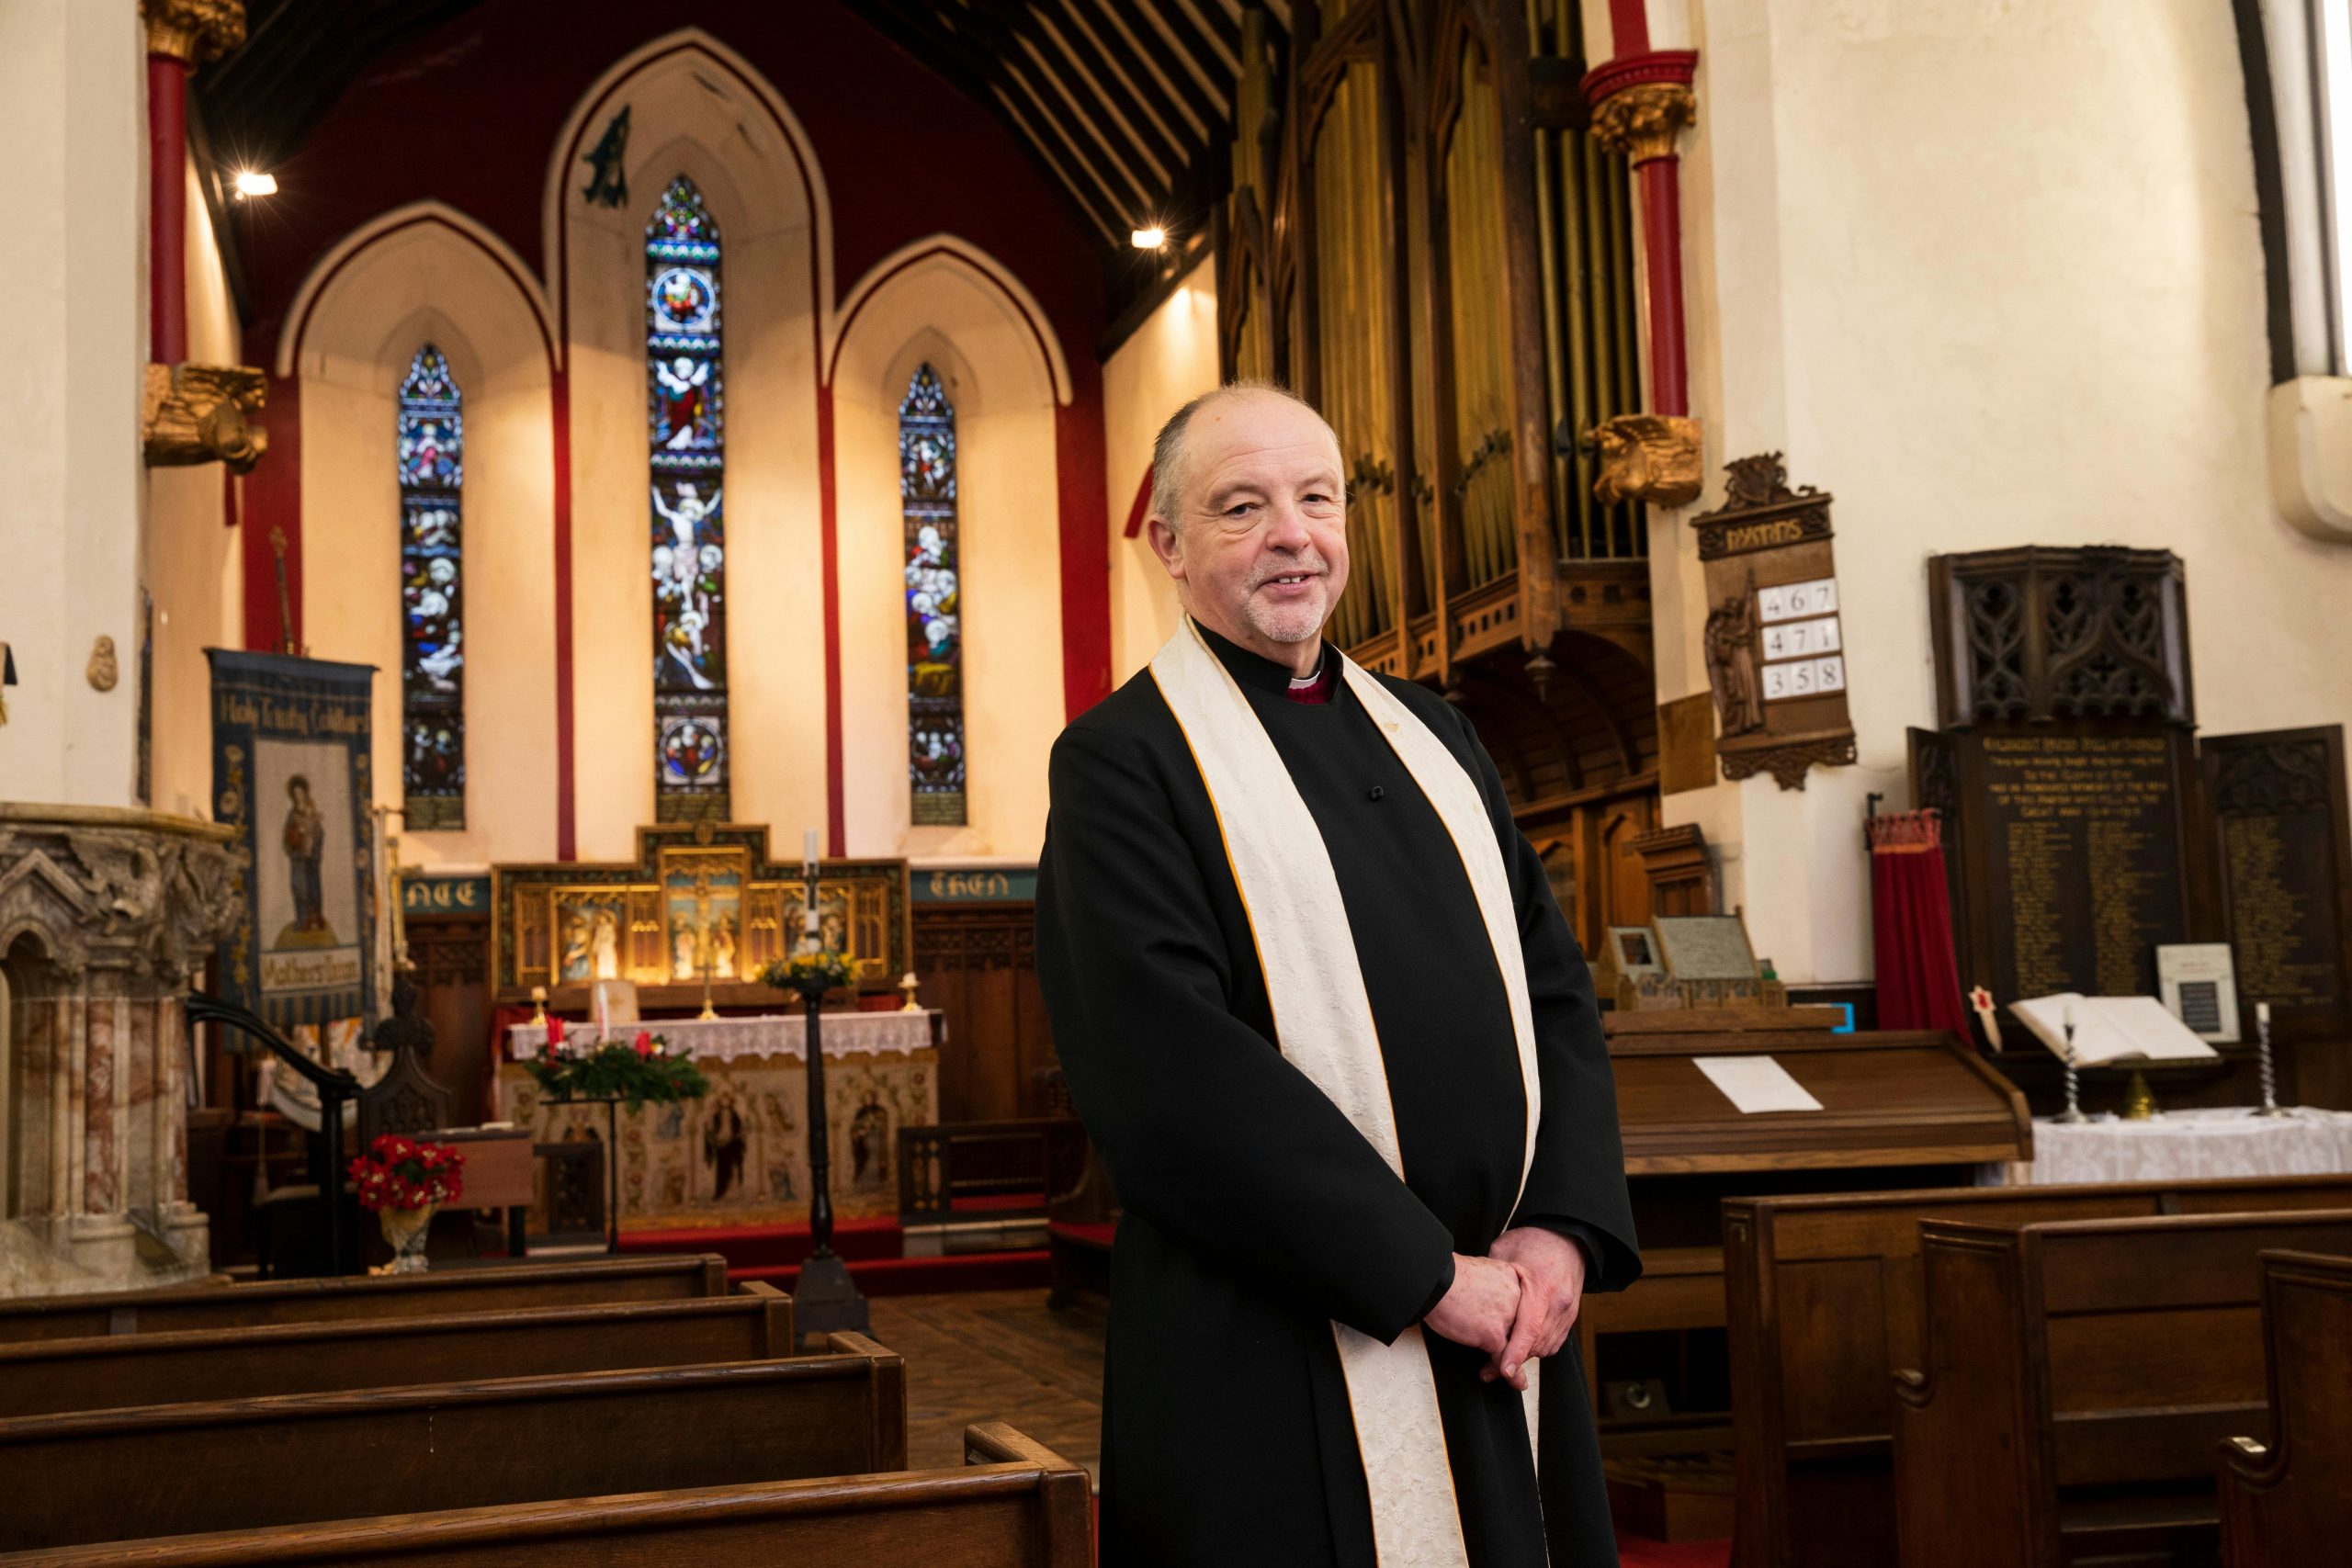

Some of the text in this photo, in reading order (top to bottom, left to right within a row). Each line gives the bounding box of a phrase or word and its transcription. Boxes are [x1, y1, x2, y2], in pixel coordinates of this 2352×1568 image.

[1768, 586, 1830, 615] 467
[1770, 626, 1830, 653] 471
[1770, 663, 1837, 694] 358
